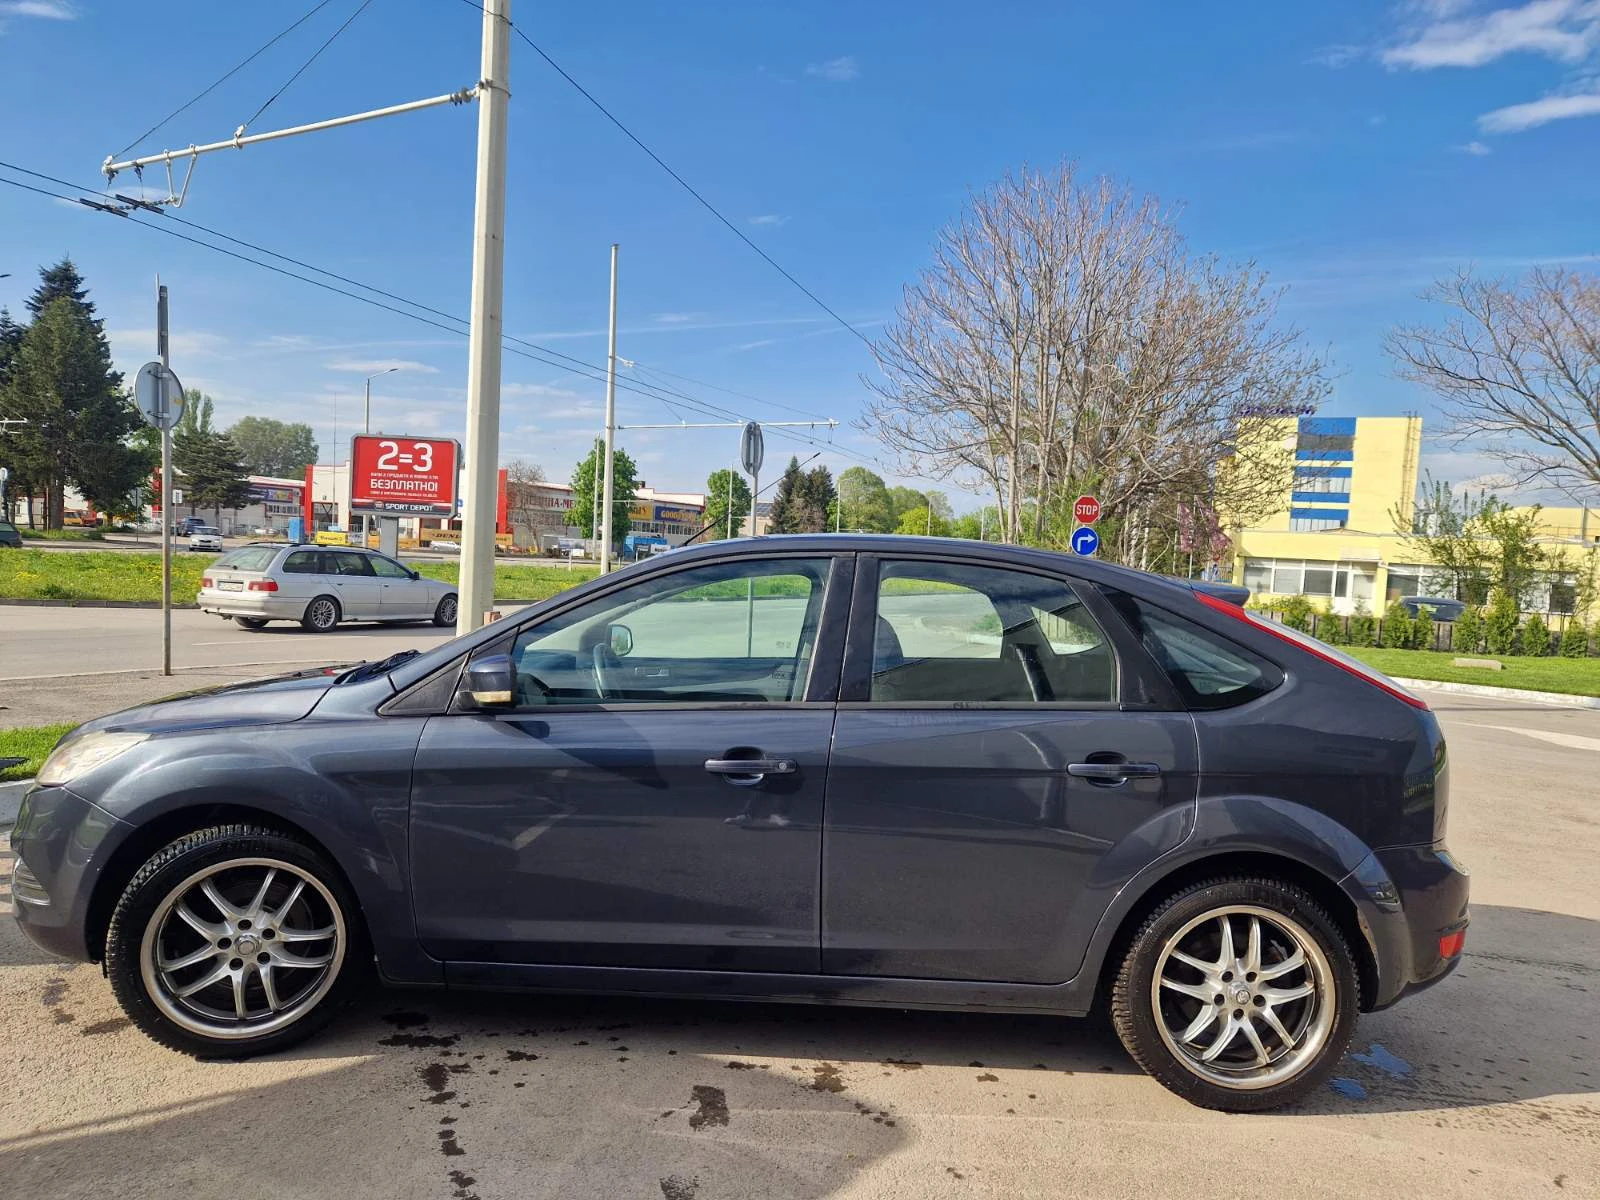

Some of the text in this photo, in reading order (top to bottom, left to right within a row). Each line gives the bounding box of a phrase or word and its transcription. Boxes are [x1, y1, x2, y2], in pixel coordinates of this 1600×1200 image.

[377, 441, 433, 472] 2=3
[370, 479, 438, 492] БЕЗПЛАТНО!
[661, 509, 697, 522] GOODY
[1076, 504, 1098, 516] STOP
